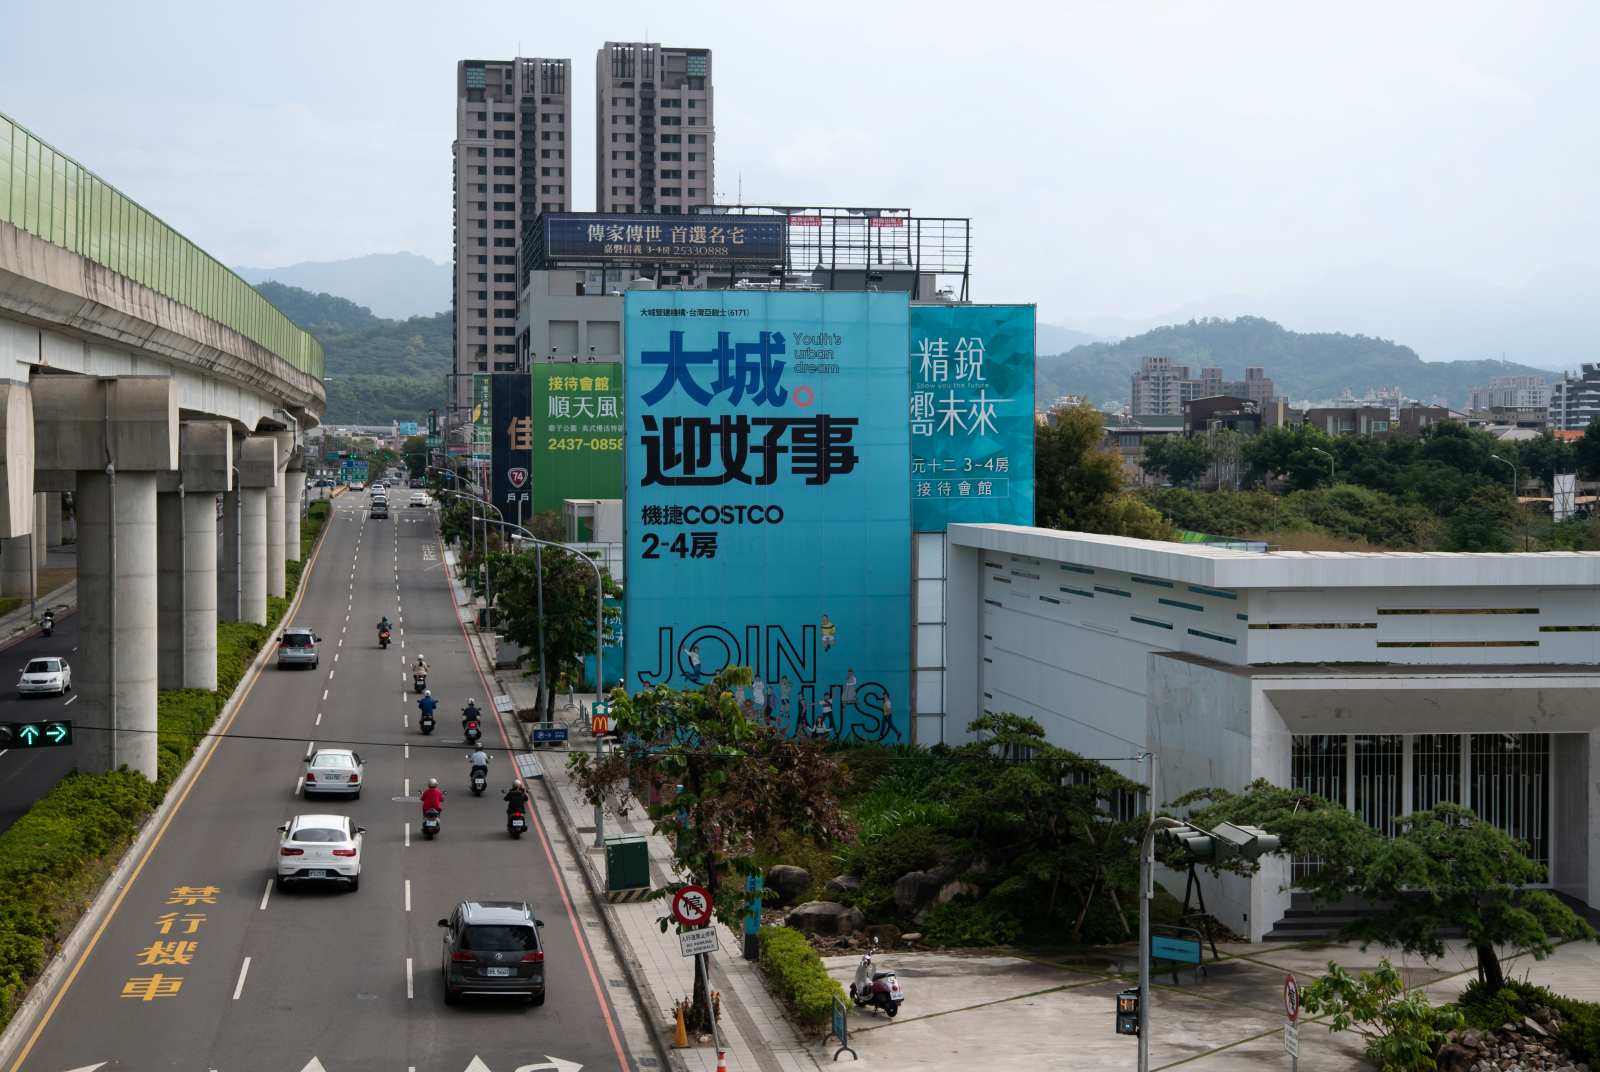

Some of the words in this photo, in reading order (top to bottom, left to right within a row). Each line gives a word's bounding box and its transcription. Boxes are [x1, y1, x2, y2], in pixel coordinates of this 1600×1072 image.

[587, 223, 662, 242] 傳家傳世
[671, 226, 745, 244] 首選名宅
[794, 347, 834, 360] urban
[911, 337, 987, 382] 精銳
[794, 362, 840, 374] dream
[548, 376, 609, 391] 接待會館
[548, 396, 624, 418] 順天風
[512, 472, 524, 481] 74
[916, 481, 993, 497] 接待會館
[641, 532, 718, 558] 2-4房
[637, 624, 816, 687] JOIN
[120, 886, 221, 1001] 禁行機車
